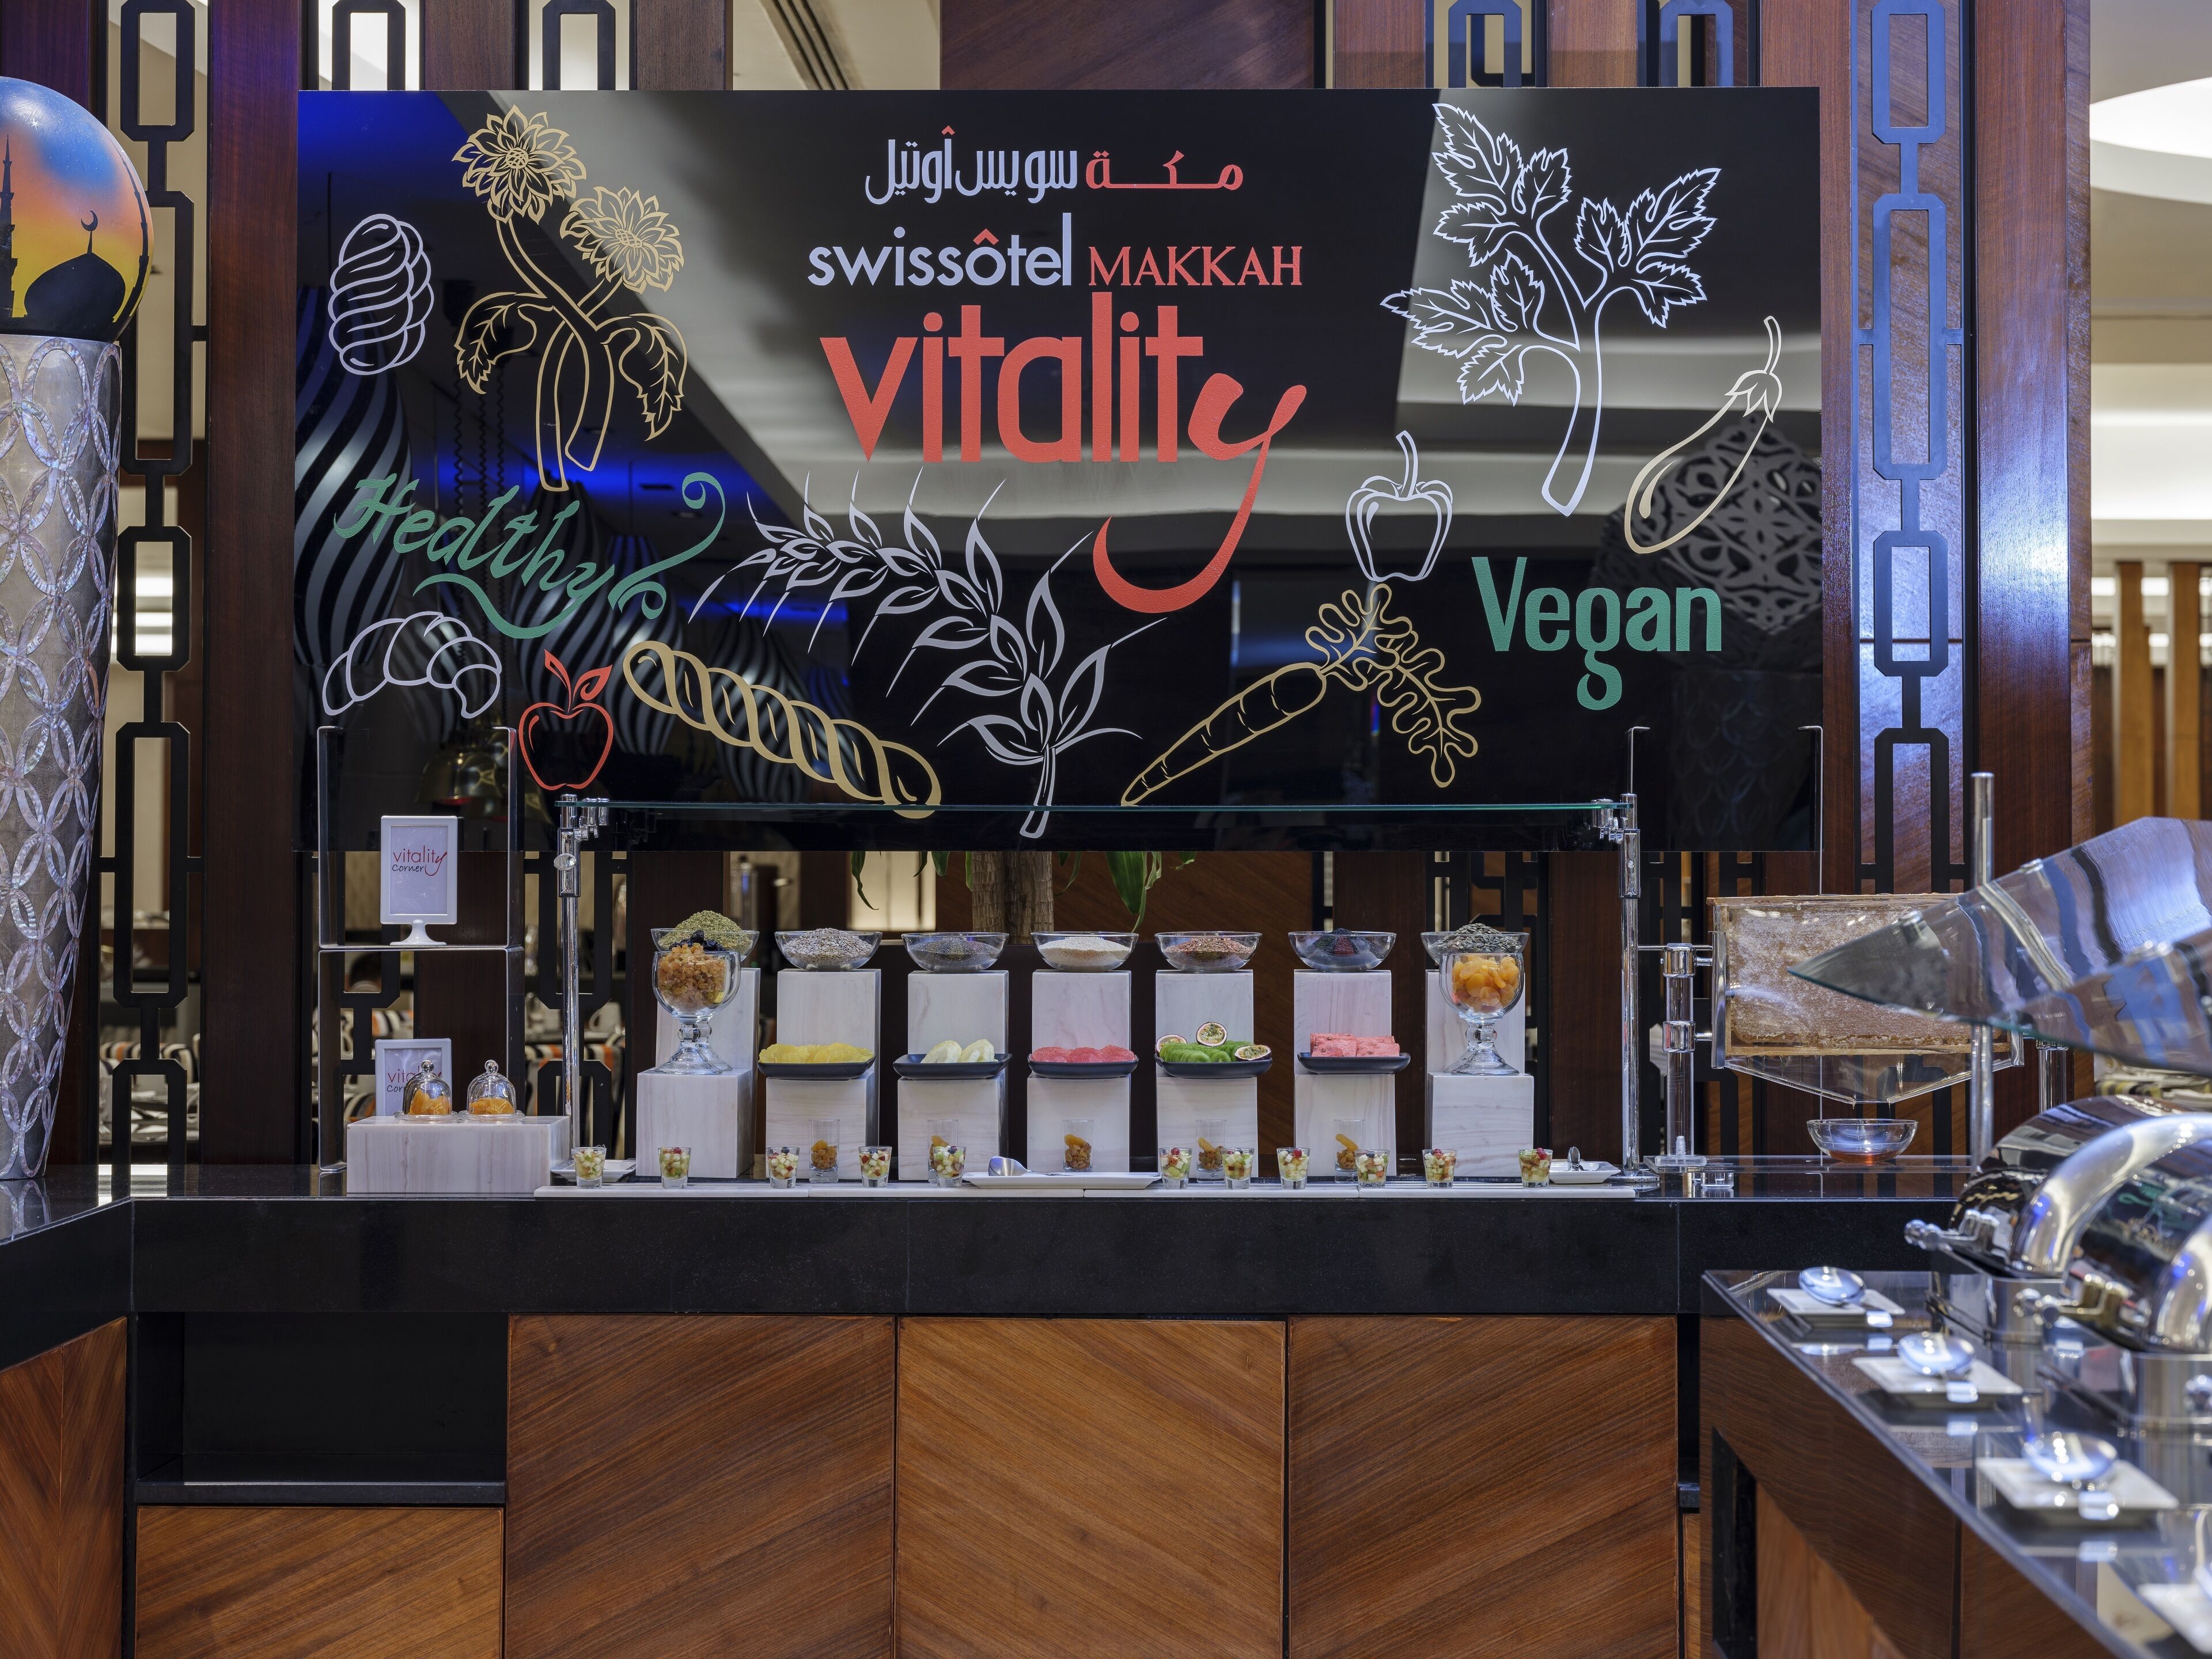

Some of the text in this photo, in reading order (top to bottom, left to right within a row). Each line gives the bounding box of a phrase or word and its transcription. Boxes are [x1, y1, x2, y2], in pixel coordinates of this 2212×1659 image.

[1085, 149, 1244, 191] مكة
[808, 213, 1302, 286] swissôtel MAKKAH
[819, 291, 1307, 613] vitality
[333, 472, 615, 639] Healthy
[1471, 556, 1722, 710] Vegan
[393, 845, 448, 876] vitality
